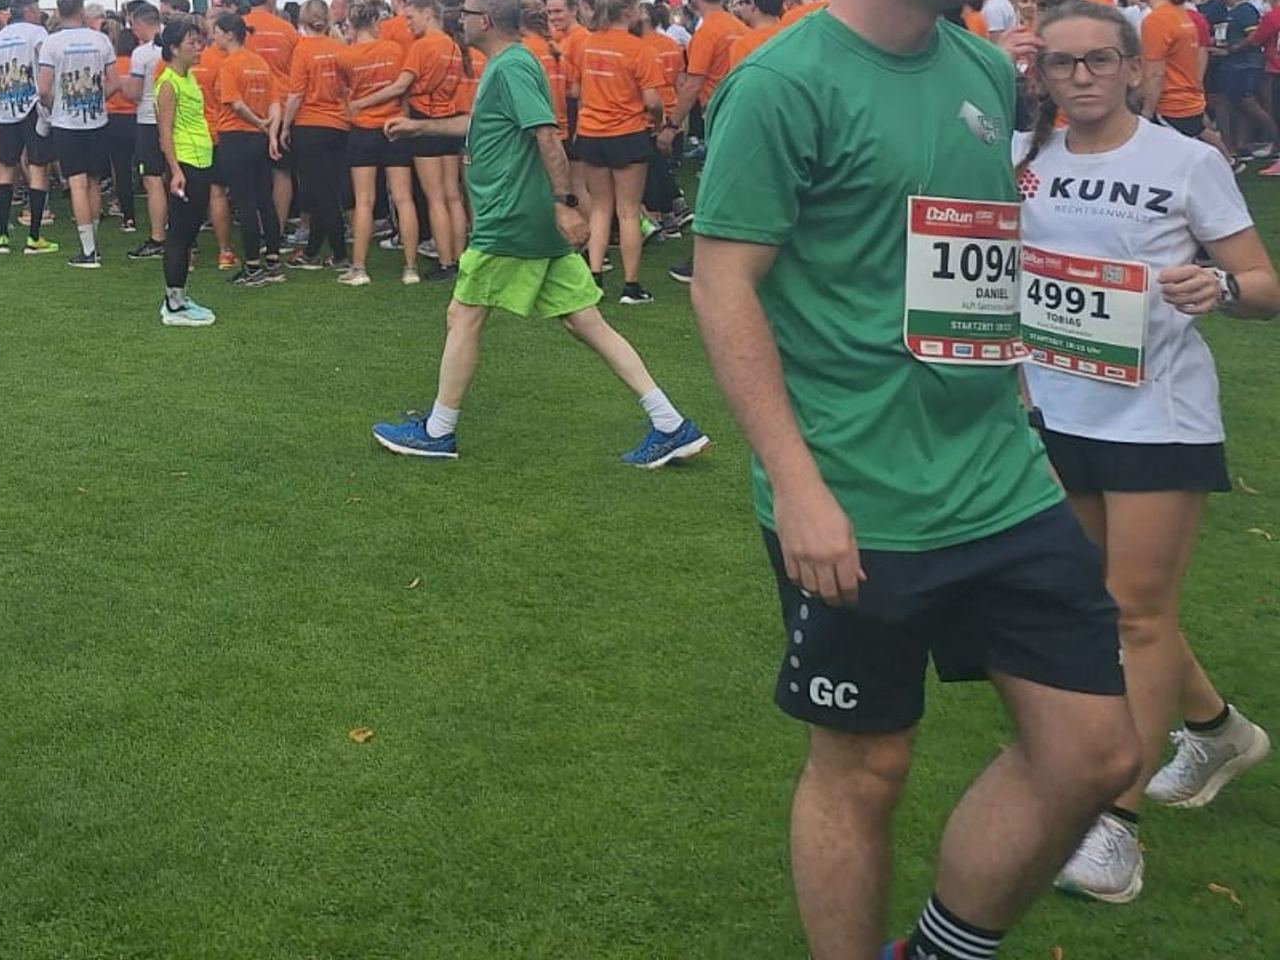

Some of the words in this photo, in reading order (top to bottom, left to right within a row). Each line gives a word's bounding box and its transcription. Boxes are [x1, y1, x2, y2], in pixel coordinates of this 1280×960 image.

[1049, 177, 1173, 214] KUNZ
[932, 242, 1016, 282] 1094
[976, 288, 1008, 299] DANIEL
[1027, 279, 1110, 319] 4991
[950, 321, 993, 331] STARTZEIT
[1047, 312, 1082, 327] TOBIAS
[809, 676, 859, 710] GC
